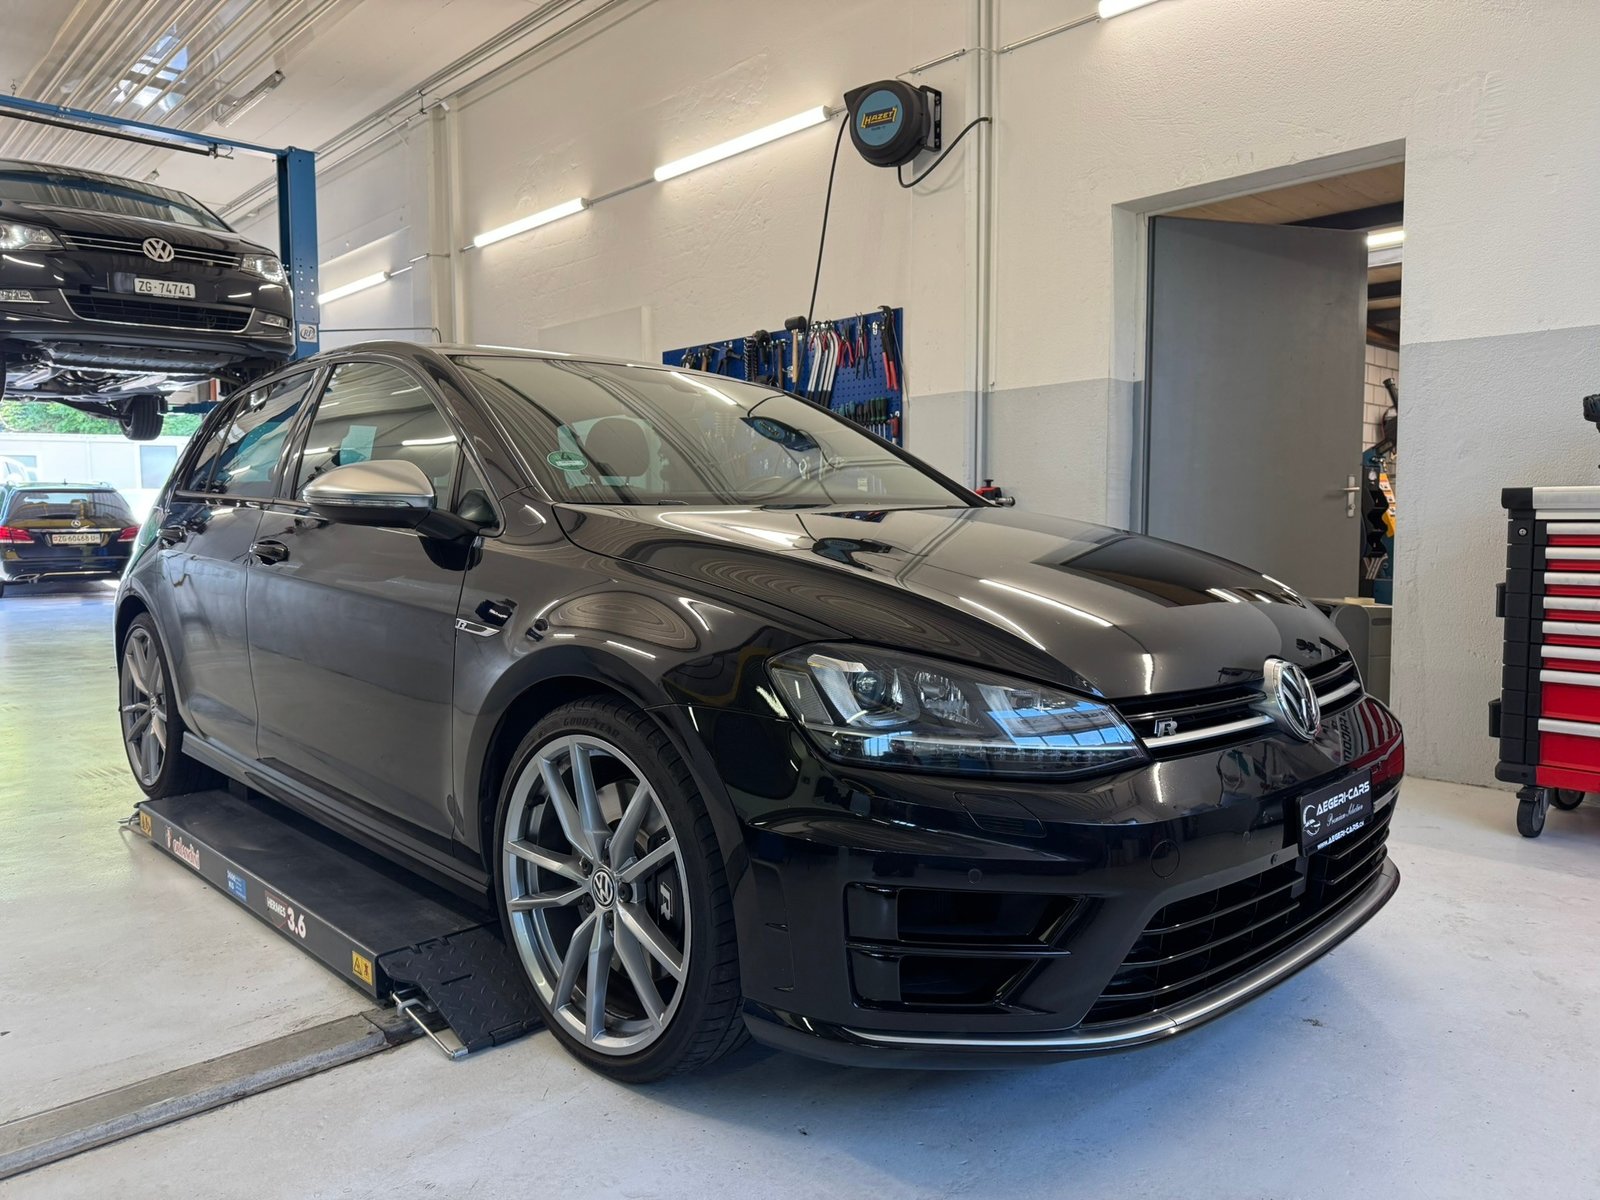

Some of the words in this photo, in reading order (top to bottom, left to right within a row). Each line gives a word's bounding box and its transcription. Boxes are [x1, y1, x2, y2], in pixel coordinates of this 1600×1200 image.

[864, 111, 894, 125] HAZET
[563, 717, 621, 738] GOODYEAR
[1154, 718, 1178, 738] R
[1316, 780, 1370, 816] AEGERI-CARS
[266, 896, 287, 918] HERMES
[287, 906, 307, 939] 3.6
